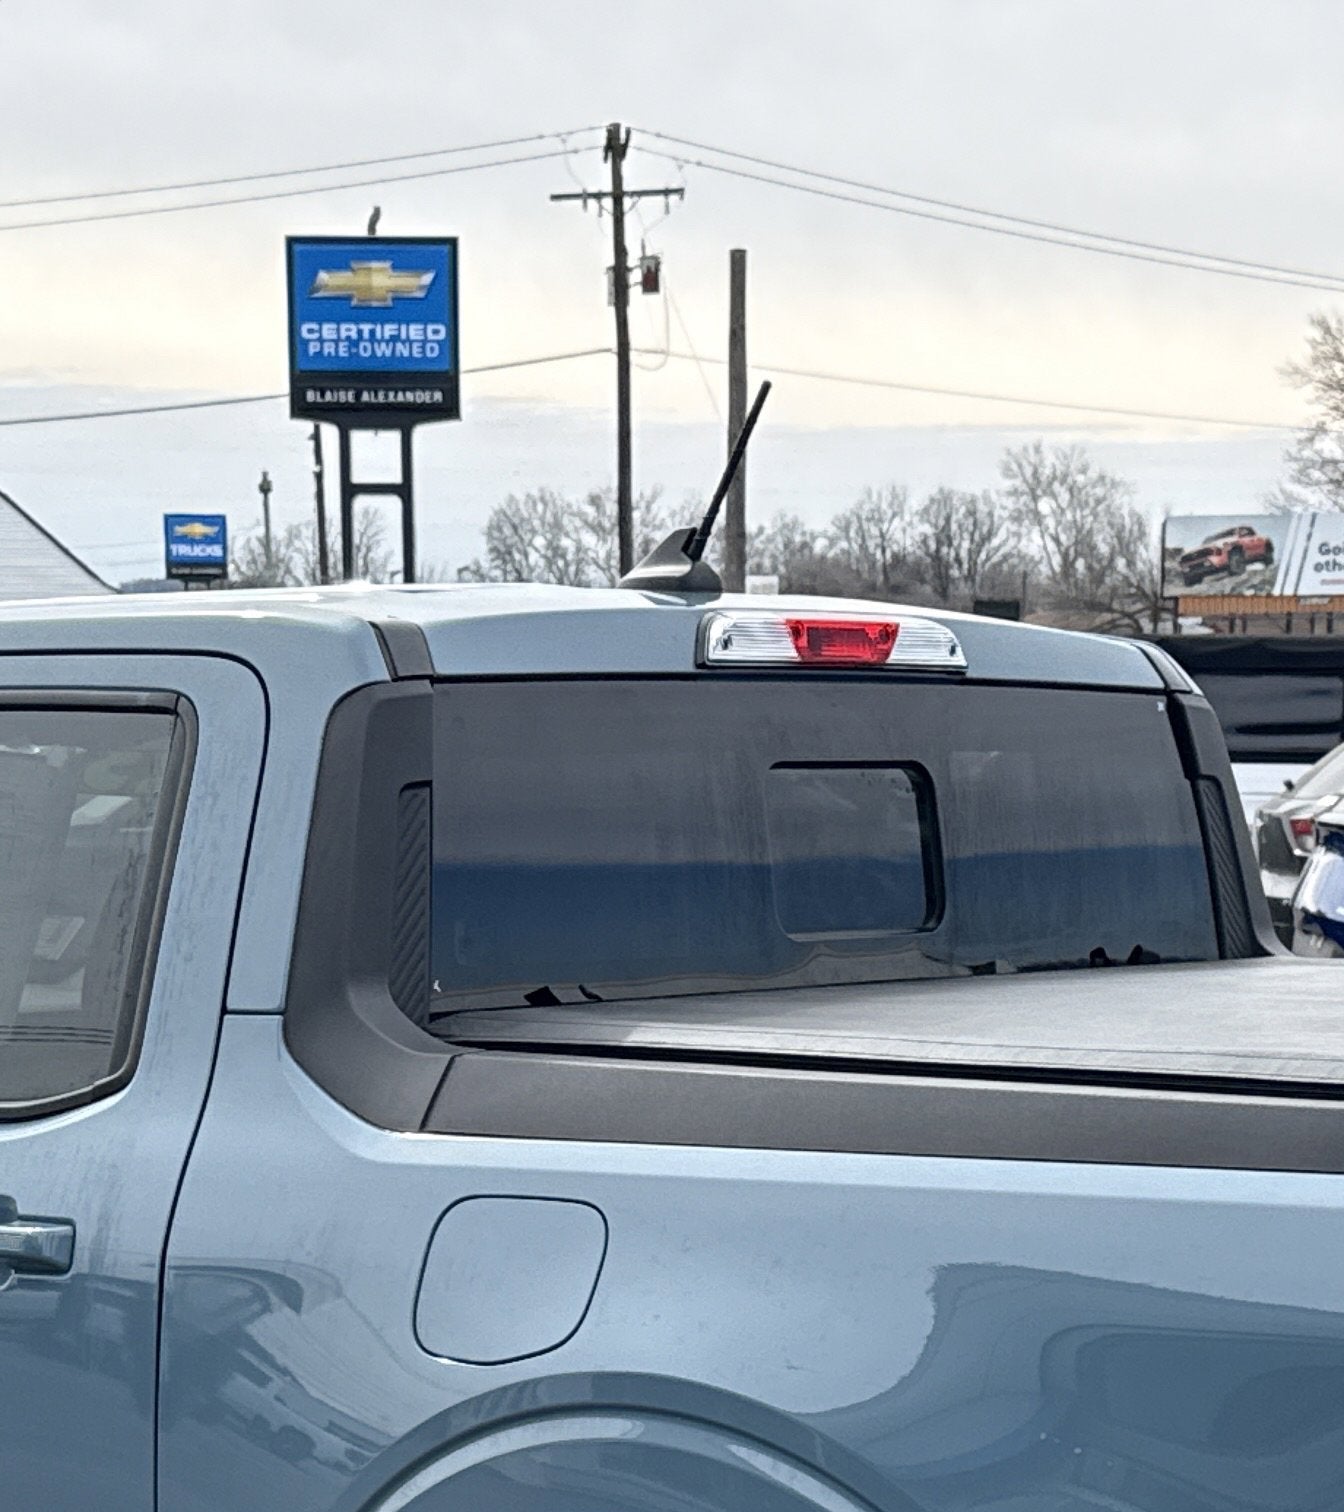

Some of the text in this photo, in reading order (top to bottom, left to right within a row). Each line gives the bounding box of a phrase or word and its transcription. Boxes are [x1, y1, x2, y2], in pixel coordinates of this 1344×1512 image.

[301, 322, 447, 341] CERTIFIED
[308, 341, 440, 358] PRE-OWNED
[306, 389, 444, 403] BLAISE ALEXANDER
